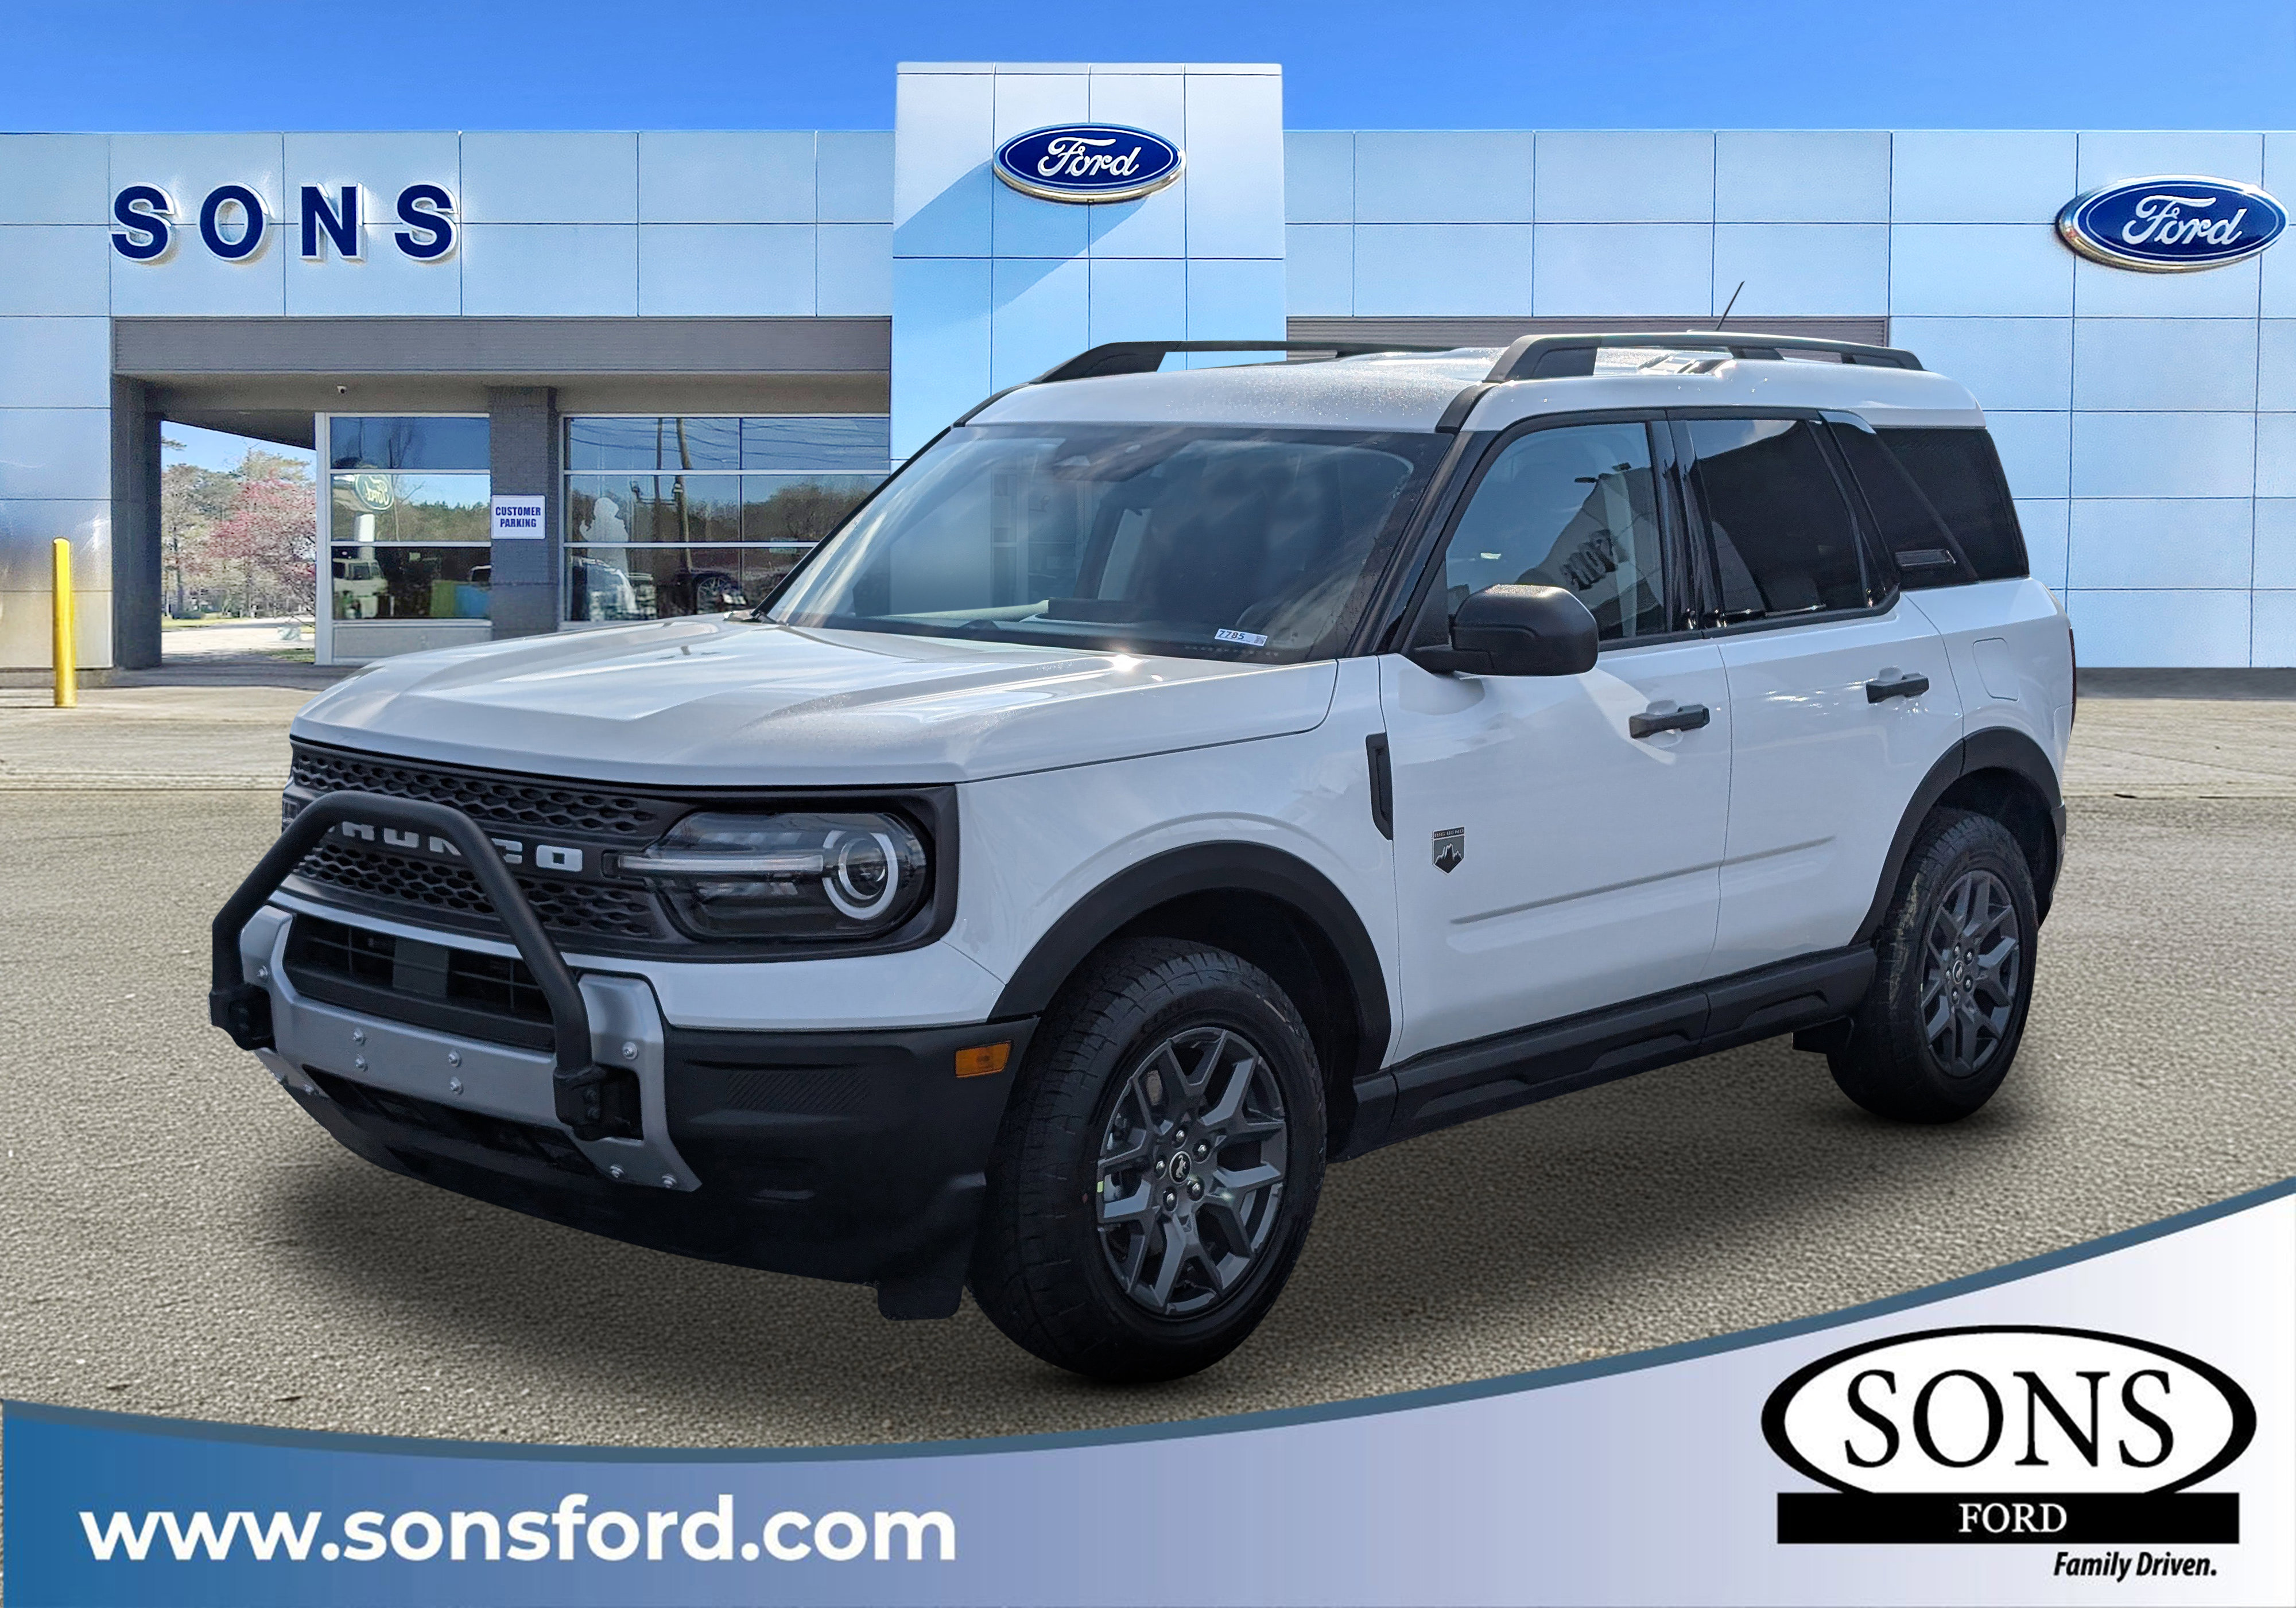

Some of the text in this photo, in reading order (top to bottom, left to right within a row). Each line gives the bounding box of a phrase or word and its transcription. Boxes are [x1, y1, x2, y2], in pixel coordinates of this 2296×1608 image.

[1038, 137, 1141, 176] Ford
[111, 182, 457, 261] SONS
[2121, 195, 2248, 246] Ford
[495, 506, 541, 516] CUSTOMER
[499, 518, 537, 527] PARKING
[1217, 630, 1246, 640] 7785
[328, 821, 583, 873] RONCO
